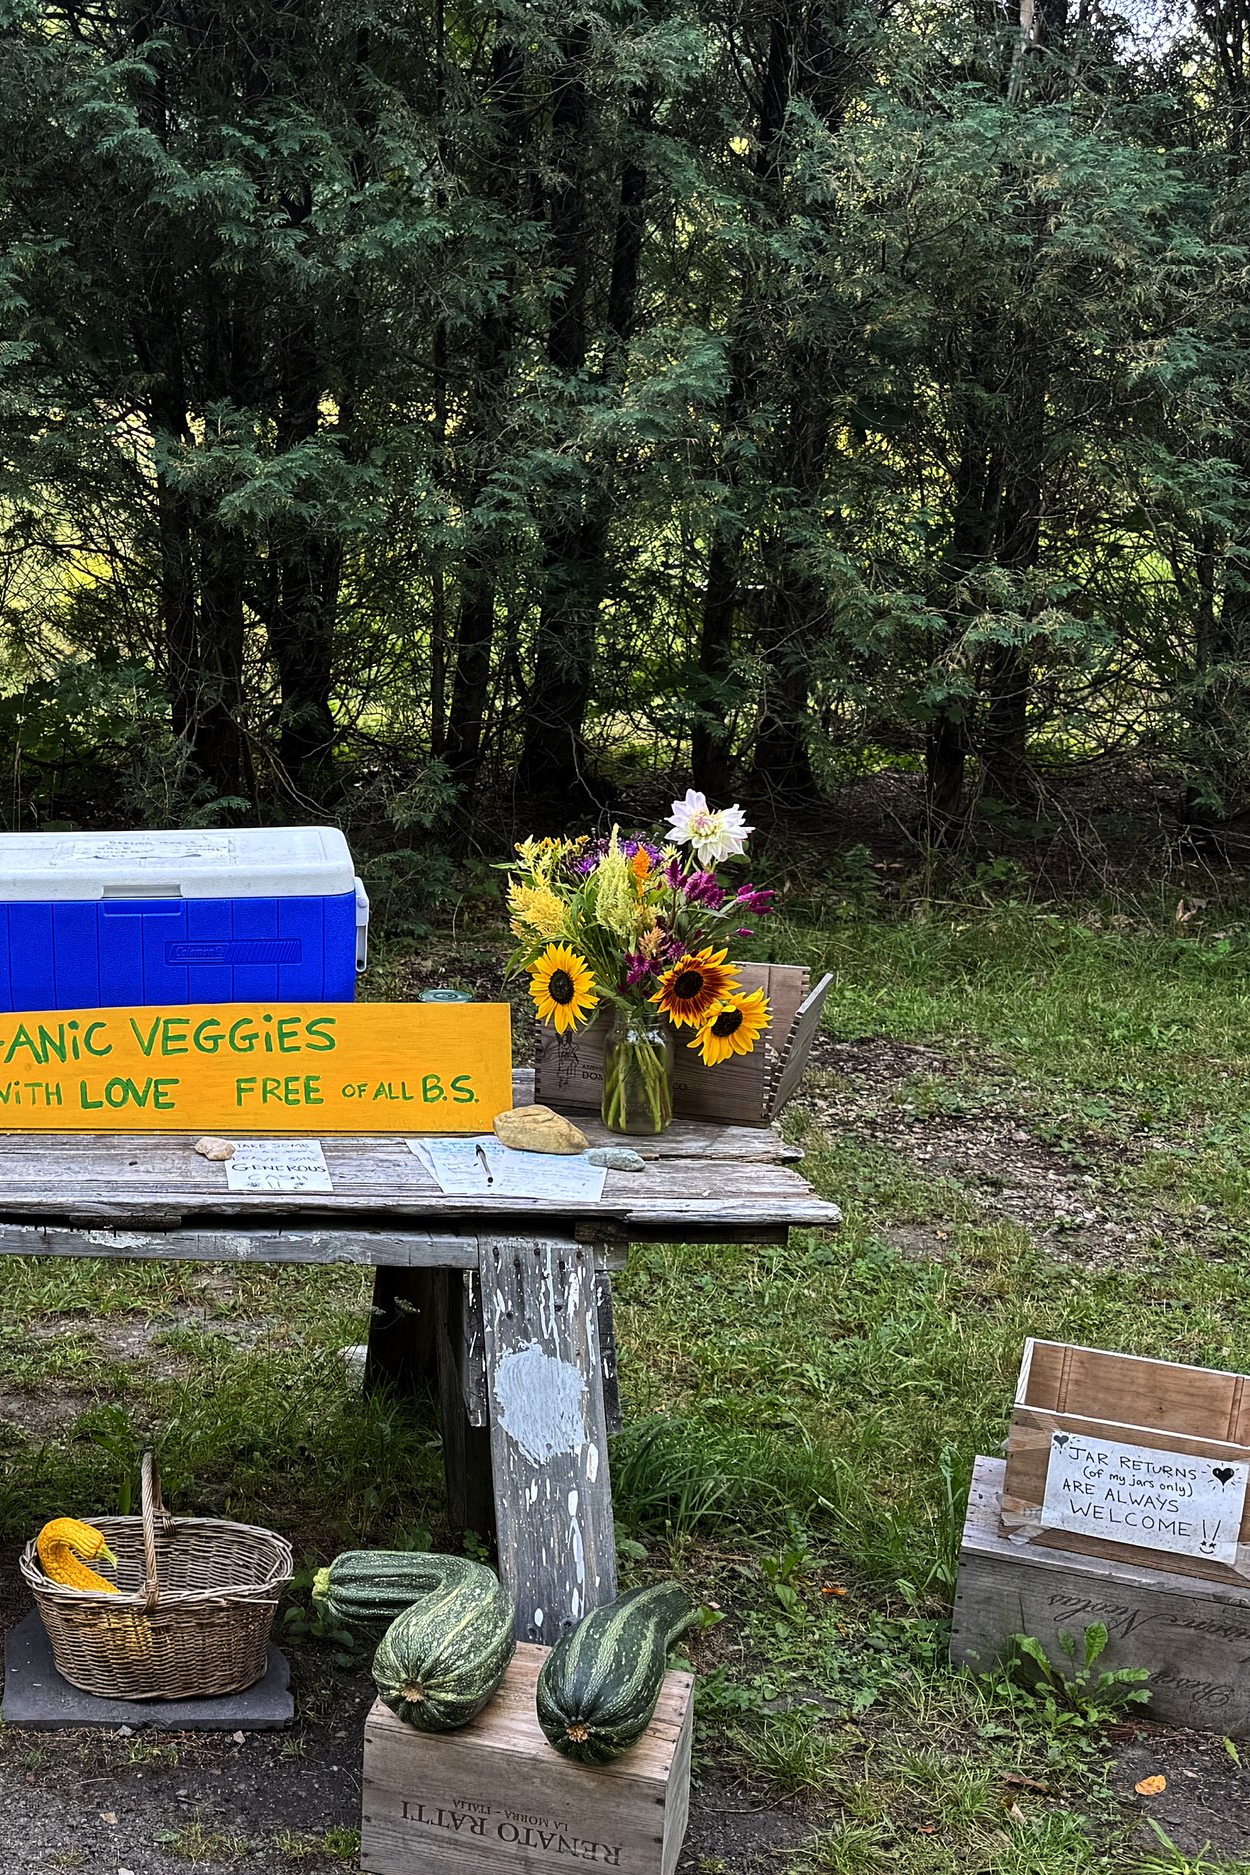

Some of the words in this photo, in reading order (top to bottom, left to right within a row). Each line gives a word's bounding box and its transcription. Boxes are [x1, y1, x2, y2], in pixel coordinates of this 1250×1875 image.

[80, 1077, 180, 1110] LOVE
[235, 1075, 324, 1106] FREE
[341, 1081, 370, 1101] OF
[372, 1077, 415, 1102] ALL
[421, 1075, 481, 1105] B.S.
[232, 1163, 327, 1172] GENEROUS
[1068, 1446, 1110, 1467] JAR
[1119, 1455, 1198, 1481] RETURNS
[1062, 1477, 1096, 1497] ARE
[1103, 1487, 1180, 1514] ALWAYS
[1108, 1470, 1129, 1488] my
[1129, 1473, 1155, 1491] jars
[1159, 1480, 1194, 1499] only)
[1069, 1500, 1193, 1538] WELCOME
[400, 1799, 489, 1837] RATTI
[452, 1799, 491, 1815] ITALIA
[504, 1810, 550, 1828] MORRA
[553, 1820, 569, 1832] LA
[497, 1821, 623, 1867] RENATO
